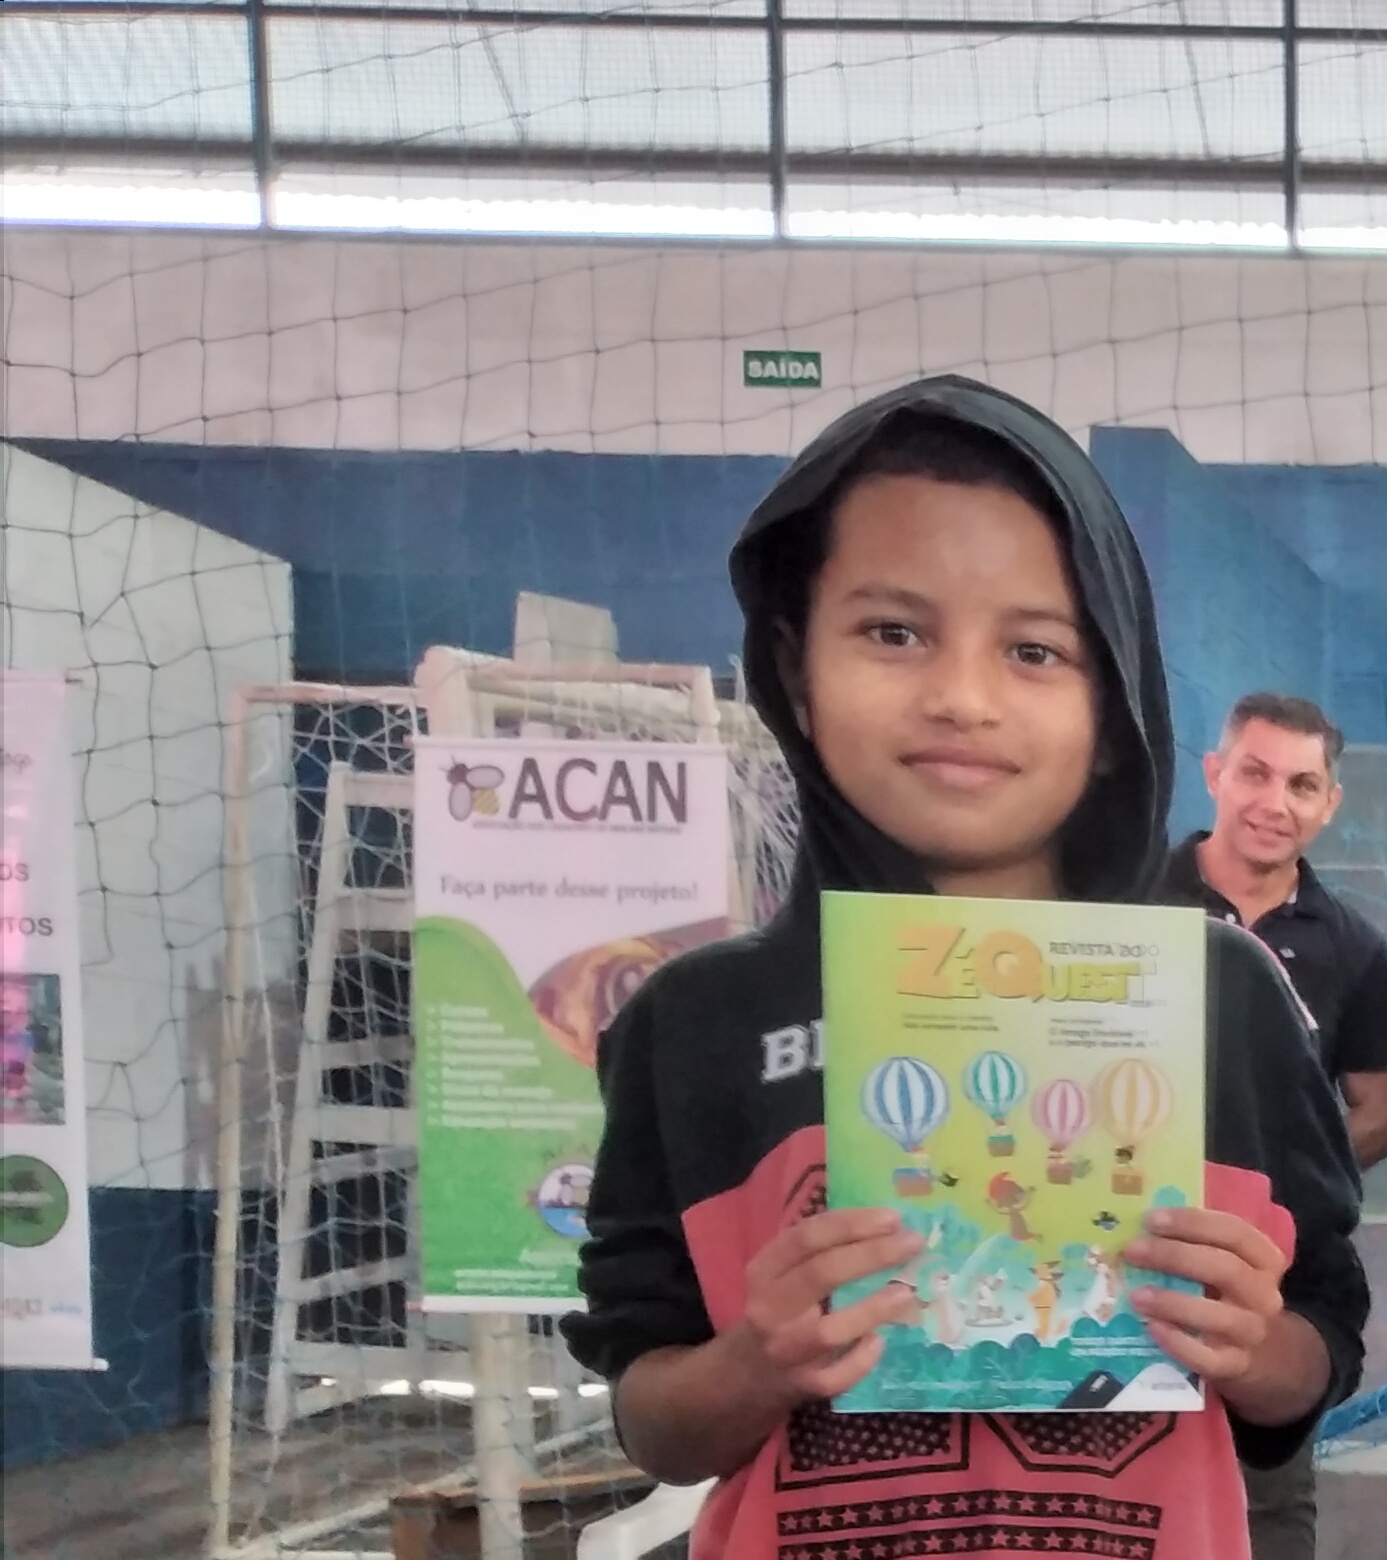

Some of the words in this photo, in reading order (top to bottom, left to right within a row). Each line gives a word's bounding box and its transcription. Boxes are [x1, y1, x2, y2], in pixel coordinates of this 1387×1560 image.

[748, 359, 819, 379] SAÍDA
[508, 757, 688, 823] ACAN
[440, 875, 486, 899] Faça
[493, 879, 547, 900] parte
[555, 877, 609, 898] desse
[617, 880, 699, 905] projeto!
